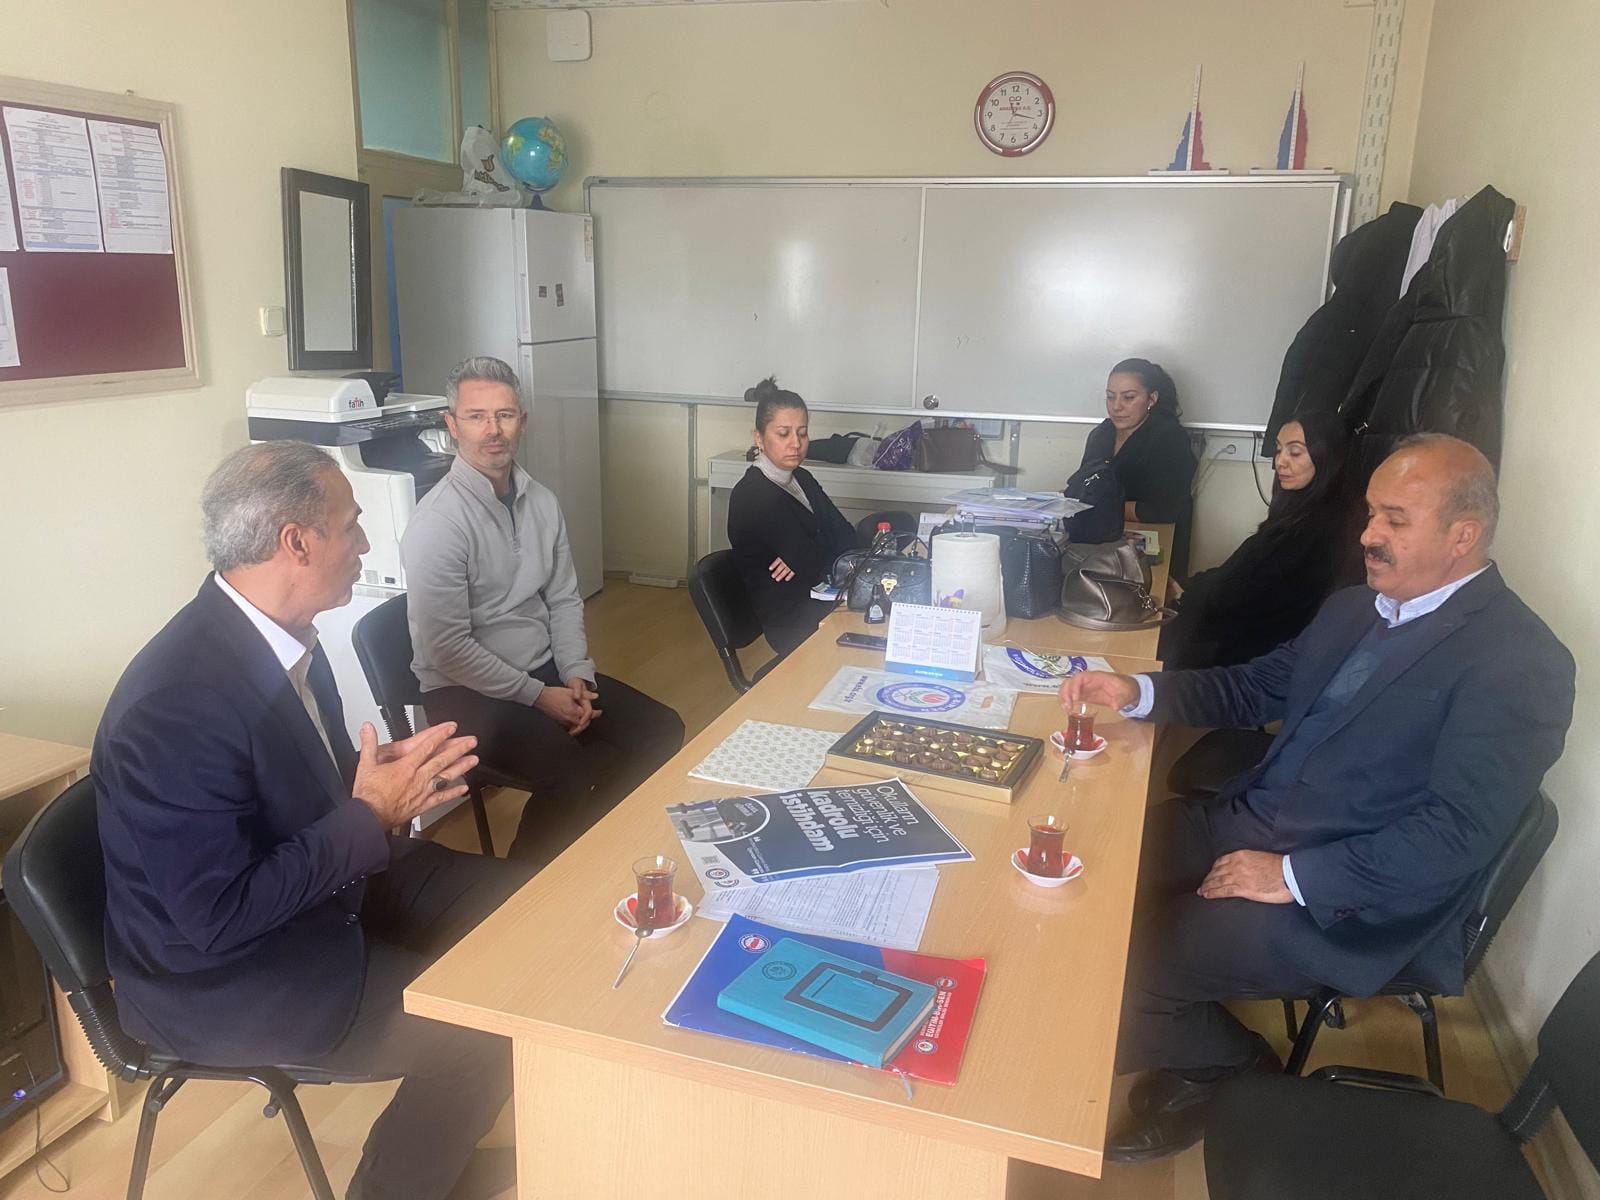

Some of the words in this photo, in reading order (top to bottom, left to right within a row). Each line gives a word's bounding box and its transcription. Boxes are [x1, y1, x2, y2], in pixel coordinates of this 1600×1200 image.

[1000, 132, 1004, 140] 7
[1010, 136, 1016, 144] 6
[779, 792, 835, 852] istihdam
[806, 790, 860, 840] kadrolu
[836, 789, 880, 826] temizliği
[865, 820, 890, 843] için
[852, 788, 898, 824] güvenlik
[888, 822, 907, 836] ve
[876, 786, 919, 825] Okulların
